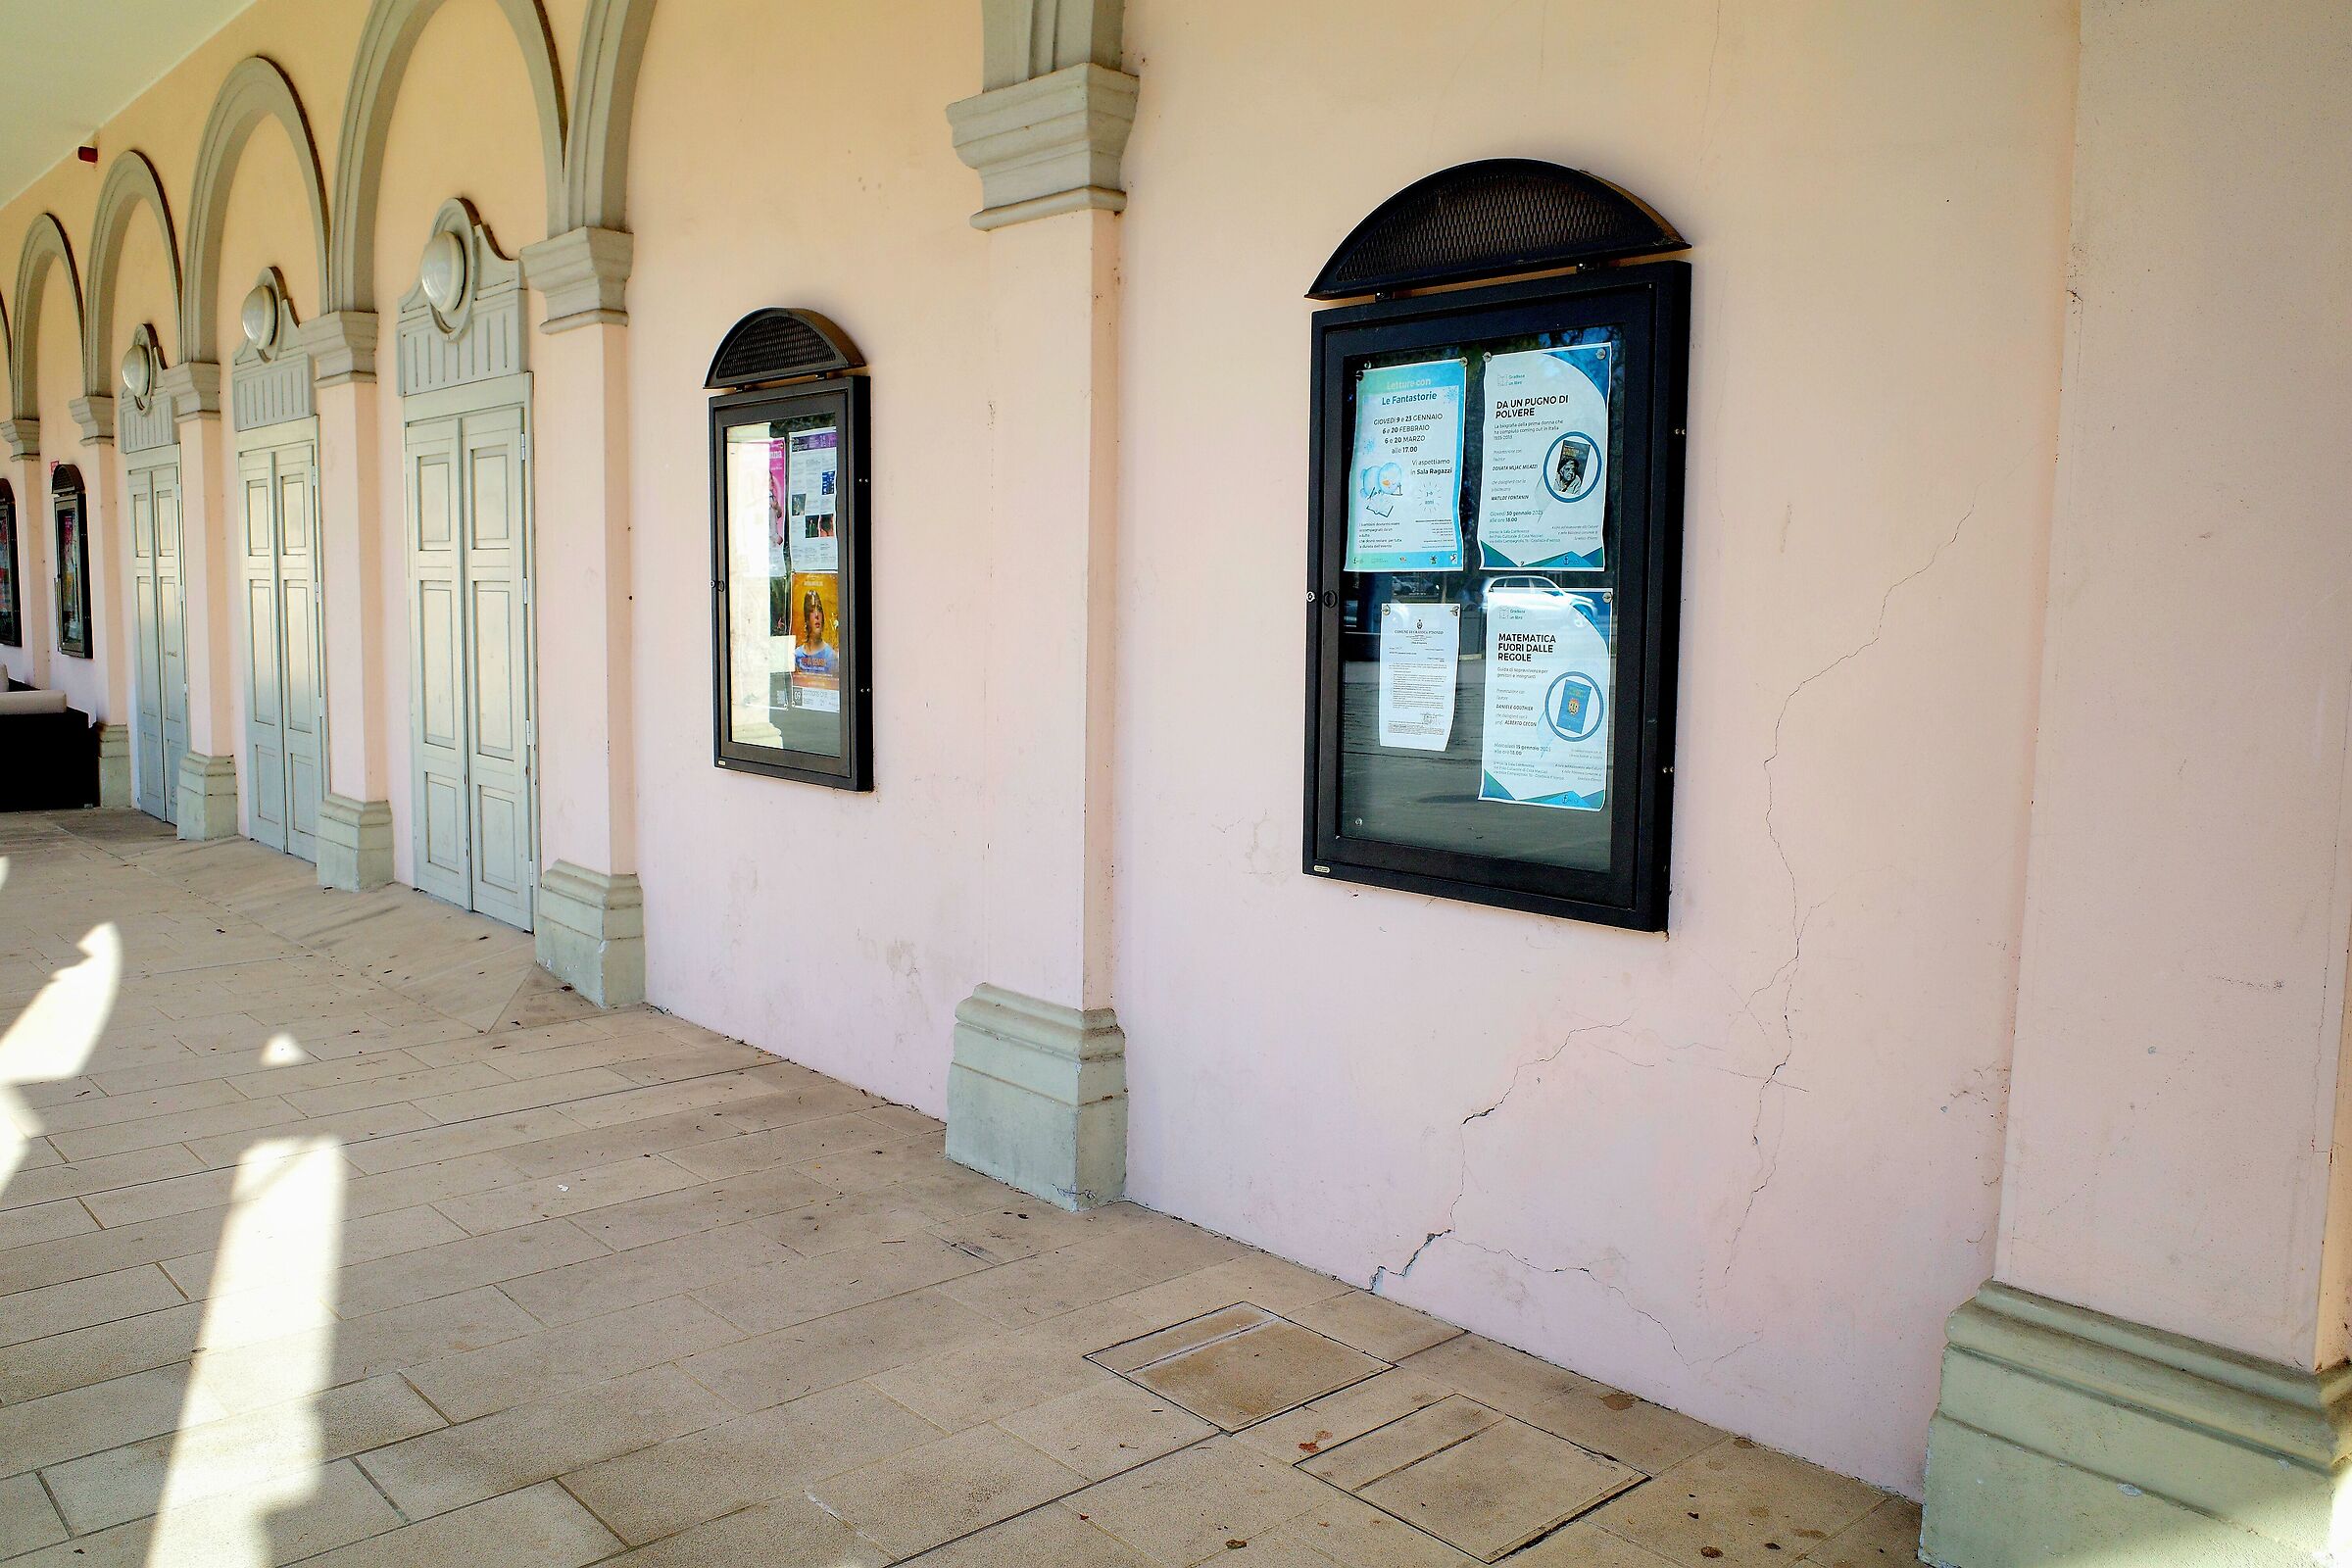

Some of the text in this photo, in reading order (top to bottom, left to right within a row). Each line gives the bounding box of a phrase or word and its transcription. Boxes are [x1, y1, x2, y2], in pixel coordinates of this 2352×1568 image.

[1382, 391, 1438, 406] Le Fantastorie
[1496, 395, 1569, 410] DA UN PUGNO DI
[1413, 413, 1444, 421] GENNAIO
[1495, 408, 1536, 419] POLVERE
[1399, 424, 1430, 433] FEBBRAIO
[1429, 466, 1452, 476] Ragazzi
[1498, 633, 1556, 643] MATEMATICA
[1498, 643, 1554, 653] FUORI DALLE
[1497, 653, 1532, 662] REGOLE
